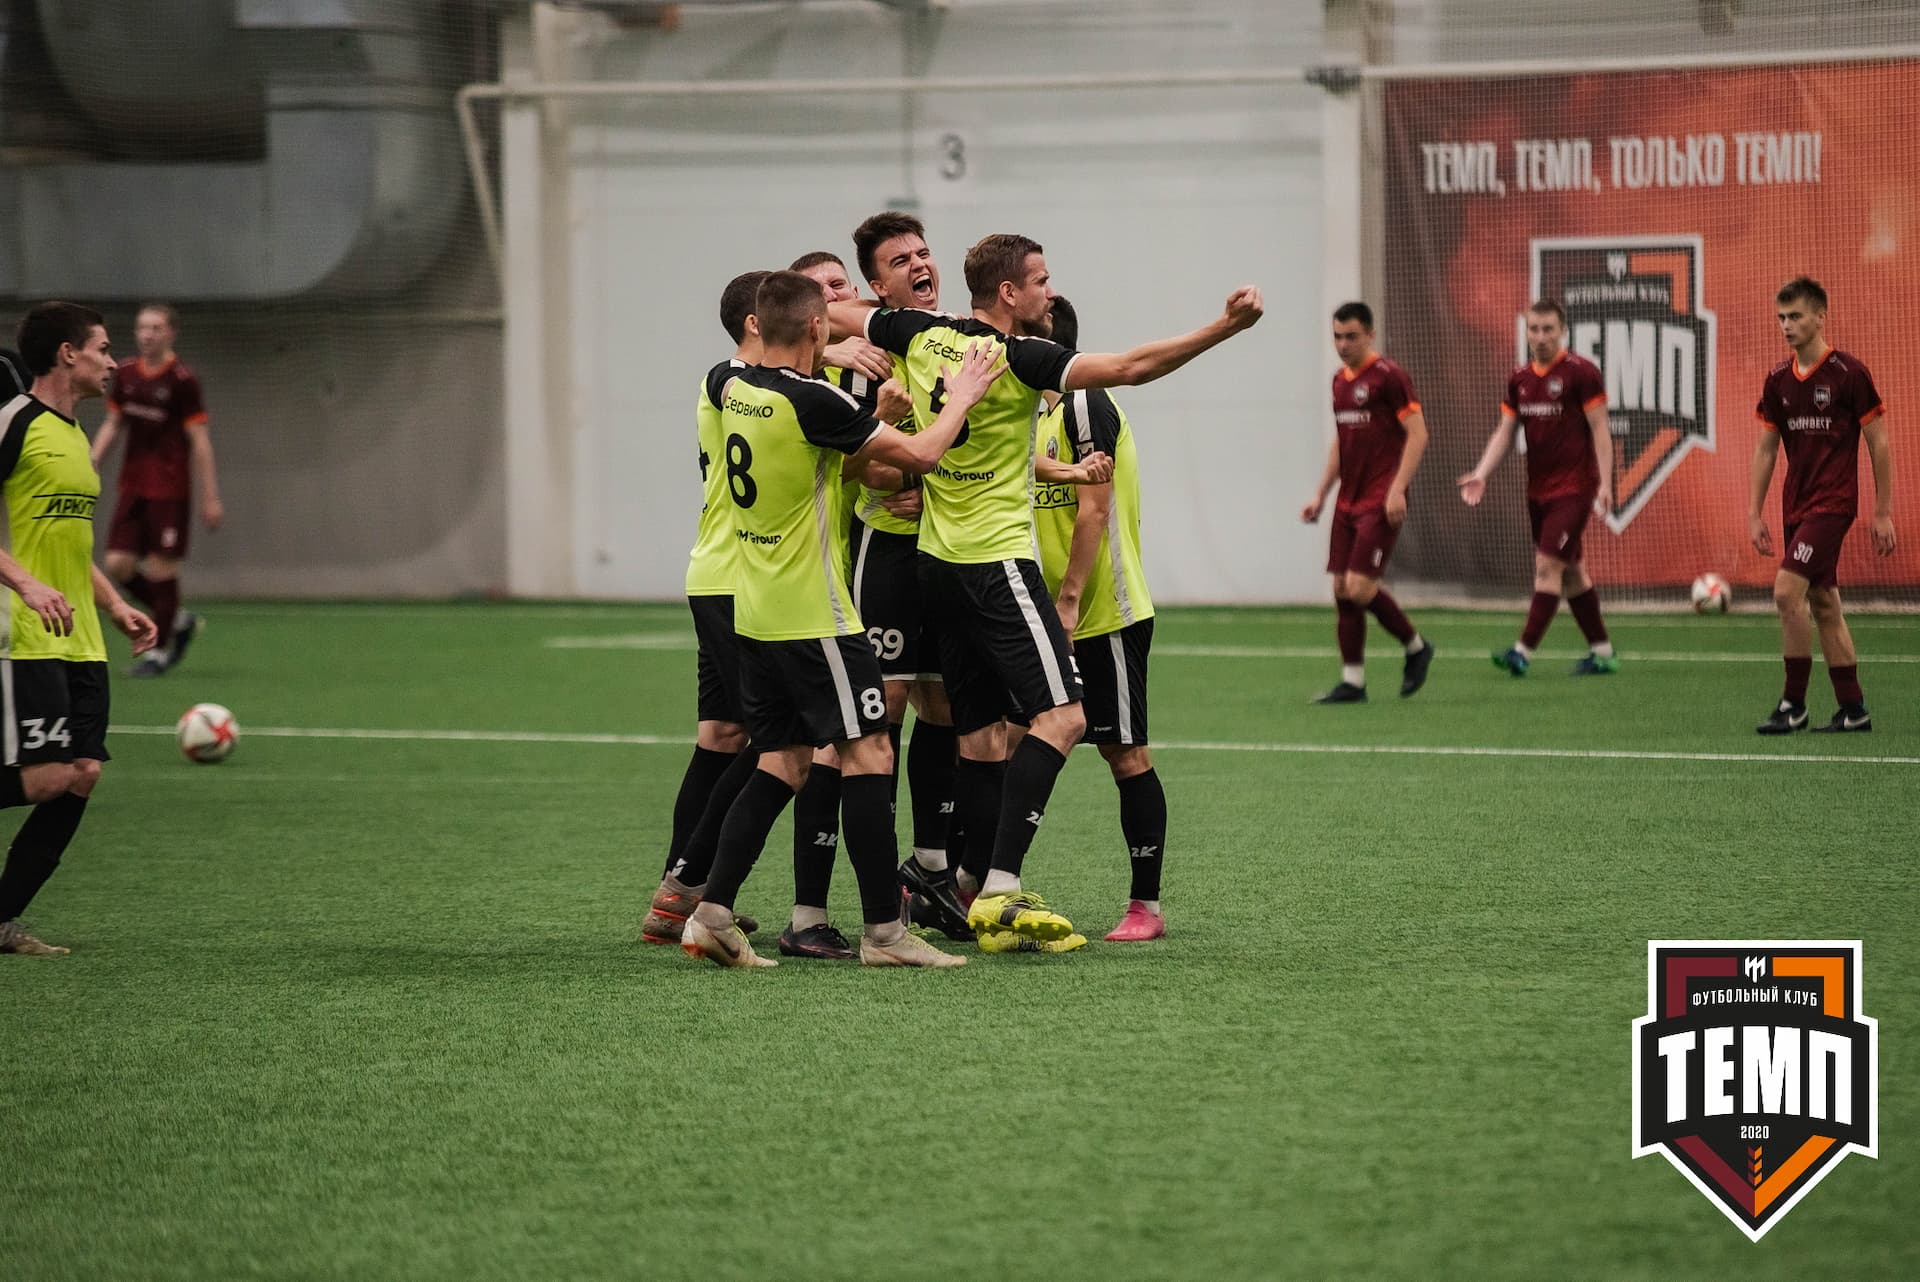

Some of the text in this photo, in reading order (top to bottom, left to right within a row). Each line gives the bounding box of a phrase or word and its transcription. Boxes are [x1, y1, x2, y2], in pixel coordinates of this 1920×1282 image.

[942, 132, 967, 181] 3
[1421, 130, 1823, 198] ТЕМП, ТЕМП, ТОЛЬКО ТЕМП!
[726, 432, 758, 510] 8
[952, 470, 995, 482] Group
[1793, 541, 1814, 564] 30
[860, 687, 886, 720] 8
[20, 716, 73, 750] 34
